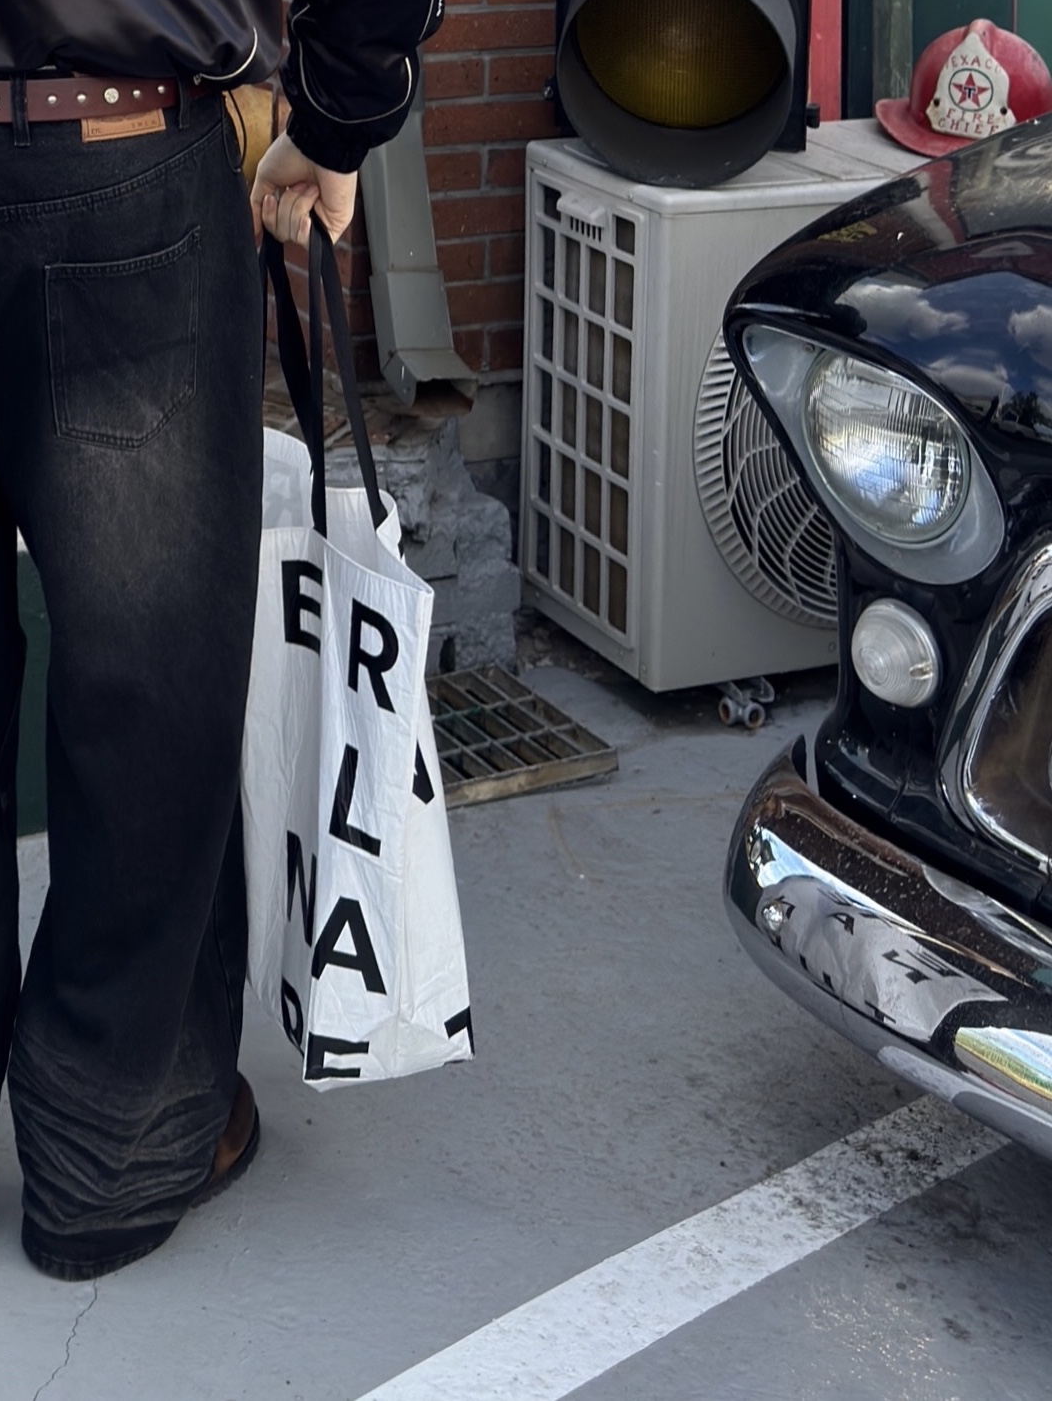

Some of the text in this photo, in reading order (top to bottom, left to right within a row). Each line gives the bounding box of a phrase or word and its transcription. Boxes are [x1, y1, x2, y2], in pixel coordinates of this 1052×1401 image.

[938, 118, 1000, 136] CHIEF
[946, 108, 996, 125] FIRE
[348, 597, 399, 713] R
[329, 744, 381, 857] L
[312, 896, 387, 996] A
